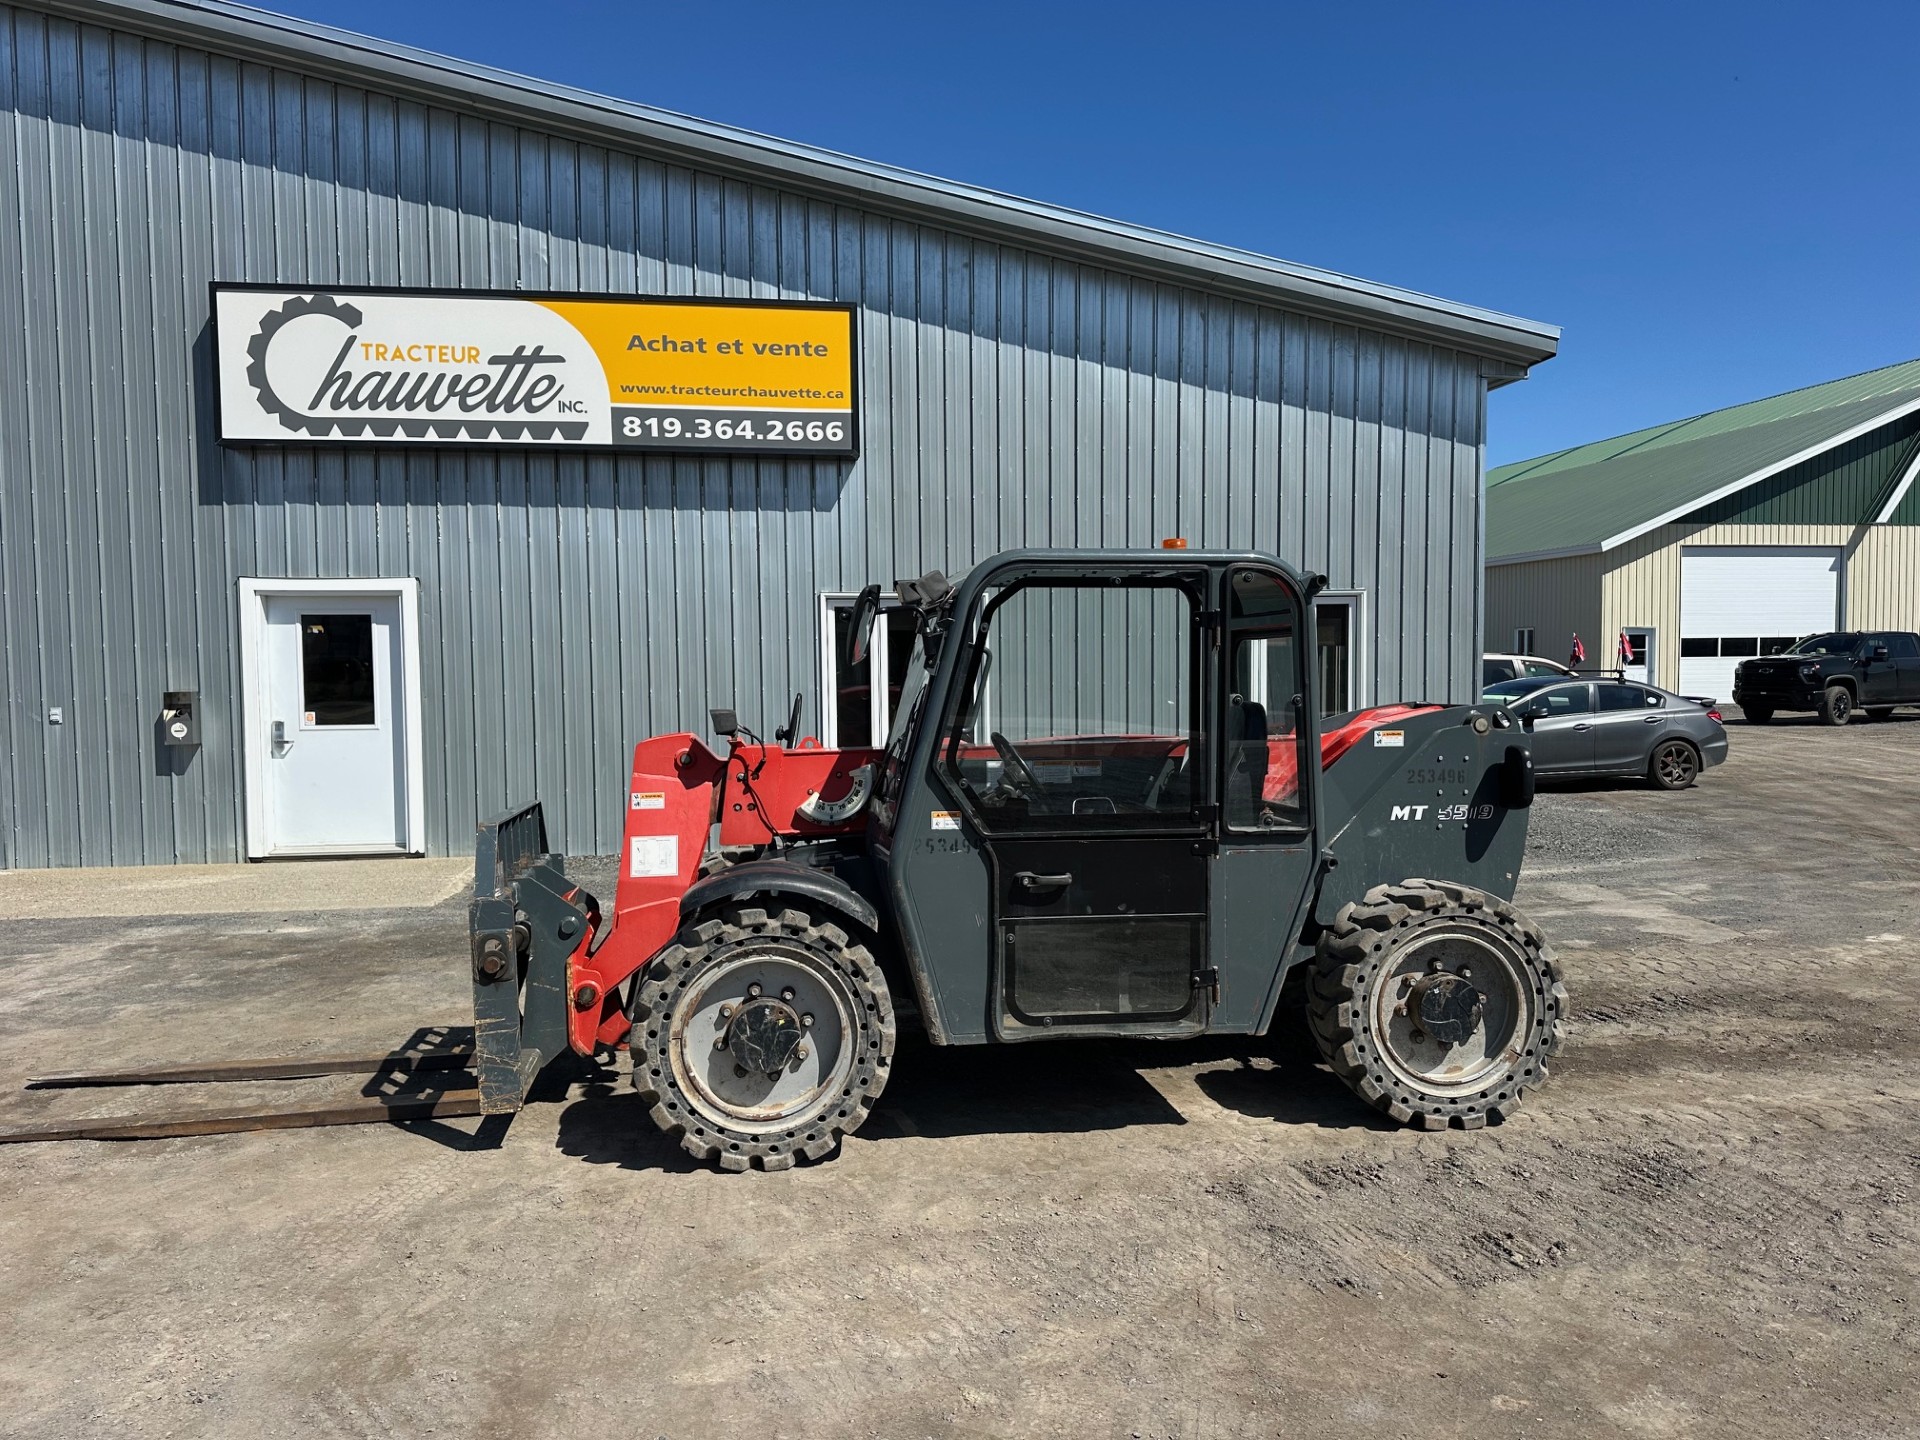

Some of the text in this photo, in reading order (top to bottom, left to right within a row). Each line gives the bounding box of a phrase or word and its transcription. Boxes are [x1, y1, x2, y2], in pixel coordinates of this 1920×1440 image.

[361, 343, 480, 364] TRACTEUR
[626, 334, 829, 358] Achat et vente
[246, 293, 588, 433] Chauvette INC.
[620, 384, 844, 400] www.tracteurchauvette.ca
[621, 416, 844, 443] 819.364.2666
[1407, 769, 1465, 784] 253496
[1390, 805, 1429, 821] MT
